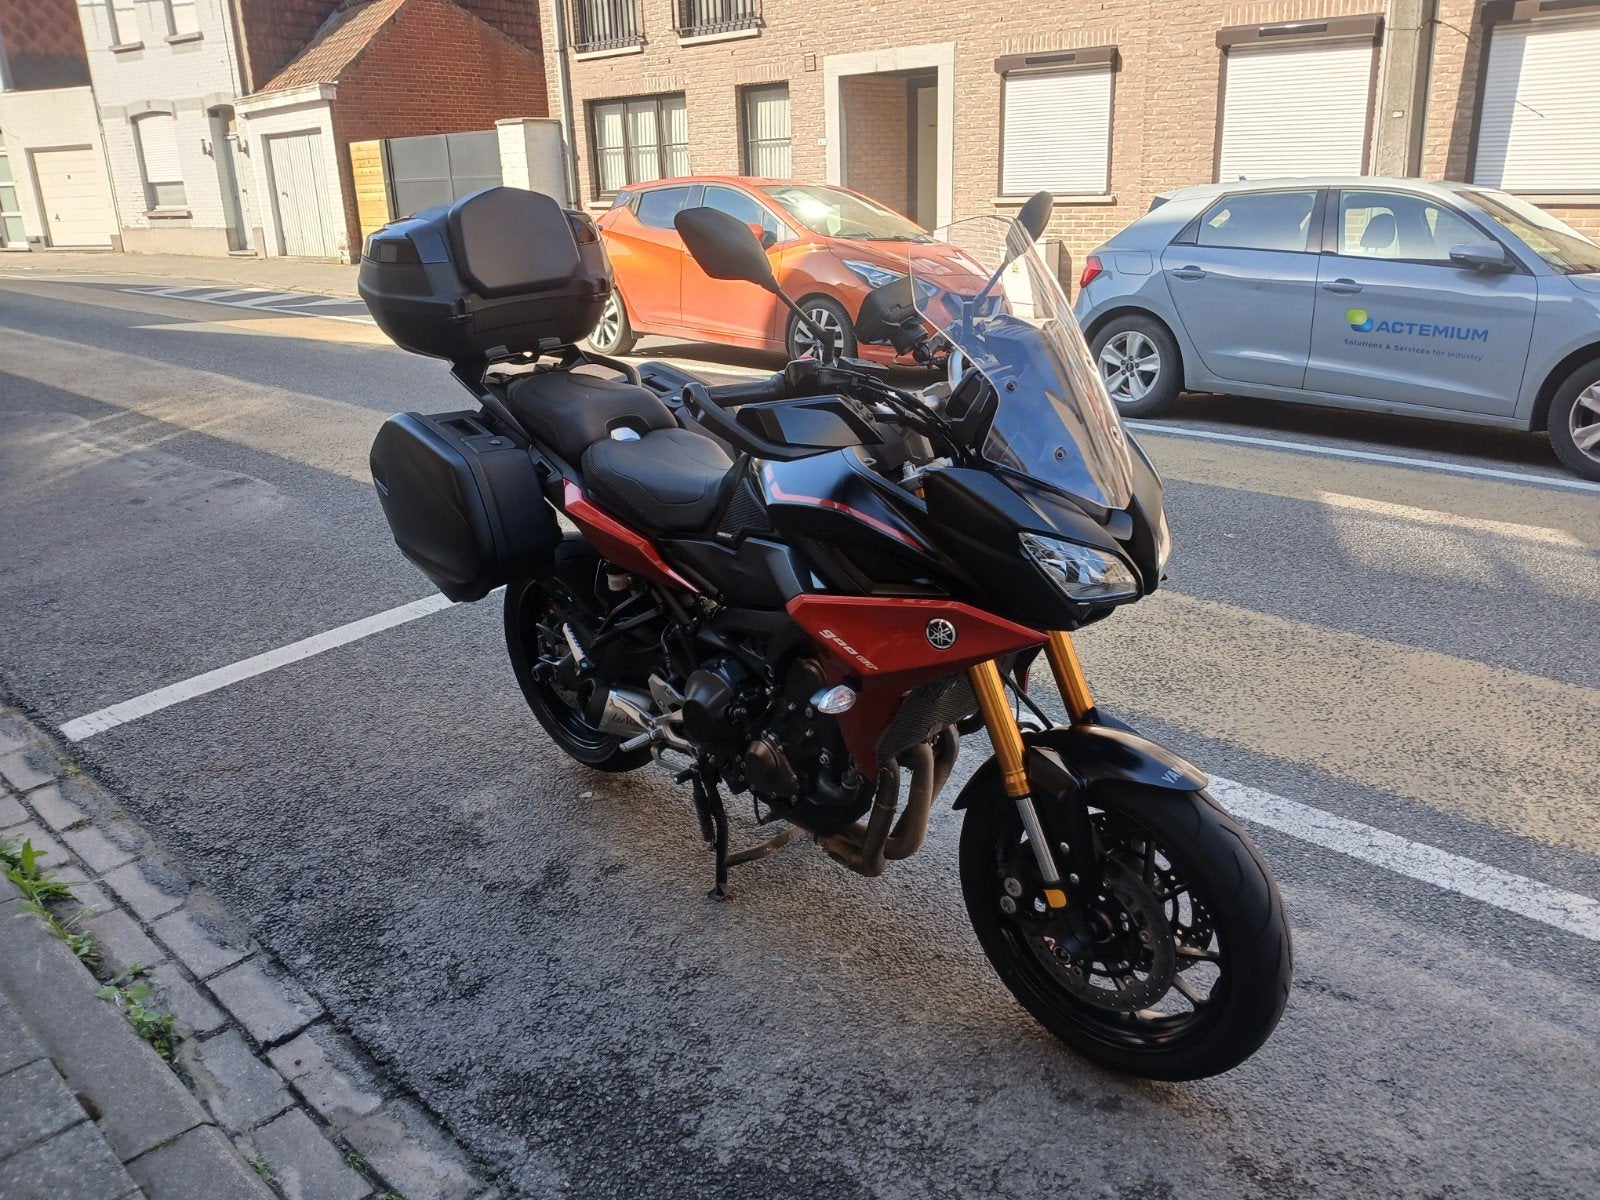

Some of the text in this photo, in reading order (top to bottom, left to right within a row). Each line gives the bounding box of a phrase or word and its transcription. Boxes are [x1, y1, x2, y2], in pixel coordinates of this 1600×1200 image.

[1376, 320, 1489, 342] ACTEMIUM
[1344, 339, 1383, 349] Solutions
[1394, 345, 1430, 355] Services
[819, 629, 858, 655] 900
